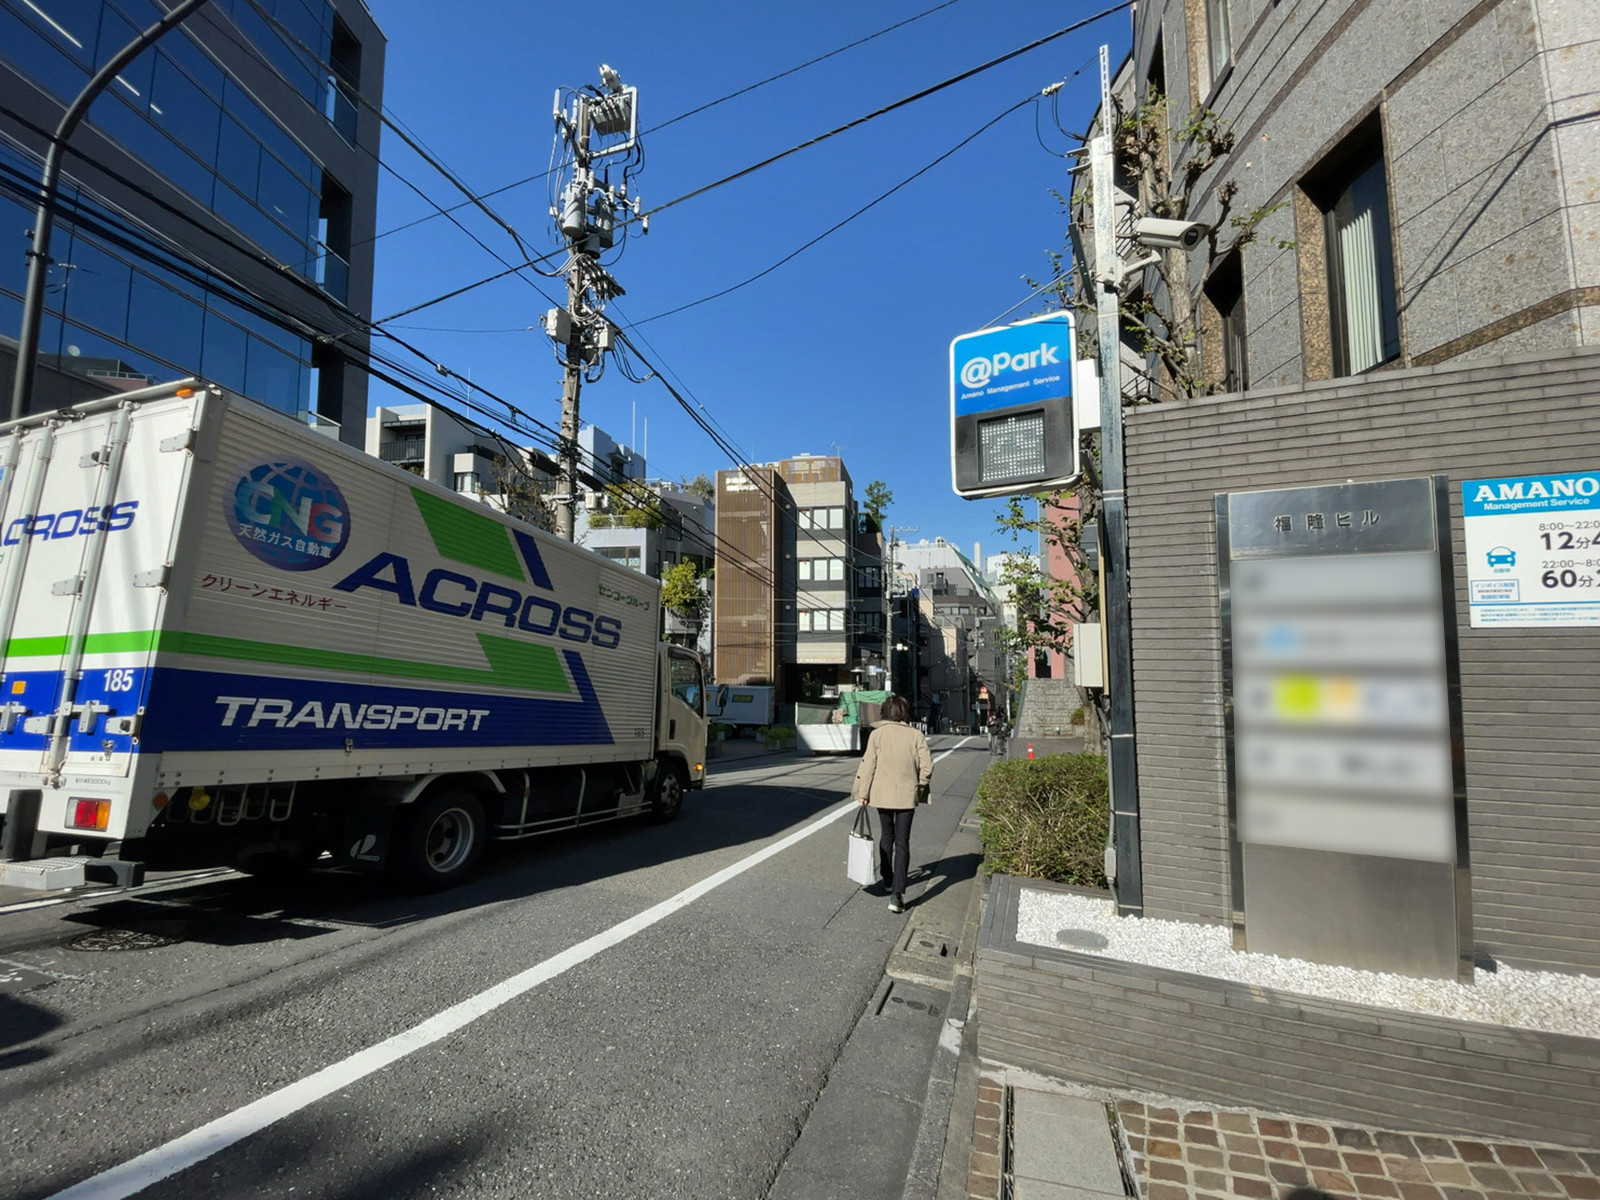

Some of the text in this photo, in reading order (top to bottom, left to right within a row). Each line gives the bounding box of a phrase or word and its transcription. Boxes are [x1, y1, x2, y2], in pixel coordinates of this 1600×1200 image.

[960, 343, 1060, 389] @Park
[961, 374, 1060, 400] Amano Management Service
[1473, 477, 1600, 502] AMANO
[1484, 497, 1590, 511] Management Service
[0, 500, 139, 547] CROSS
[240, 480, 343, 543] CNG
[238, 522, 332, 560] 天然ガス自動車
[201, 573, 348, 611] クリーンエネルギー
[1541, 569, 1600, 589] 60分
[333, 551, 622, 650] ACROSS
[103, 668, 134, 692] 185
[215, 695, 490, 731] TRANSPORT
